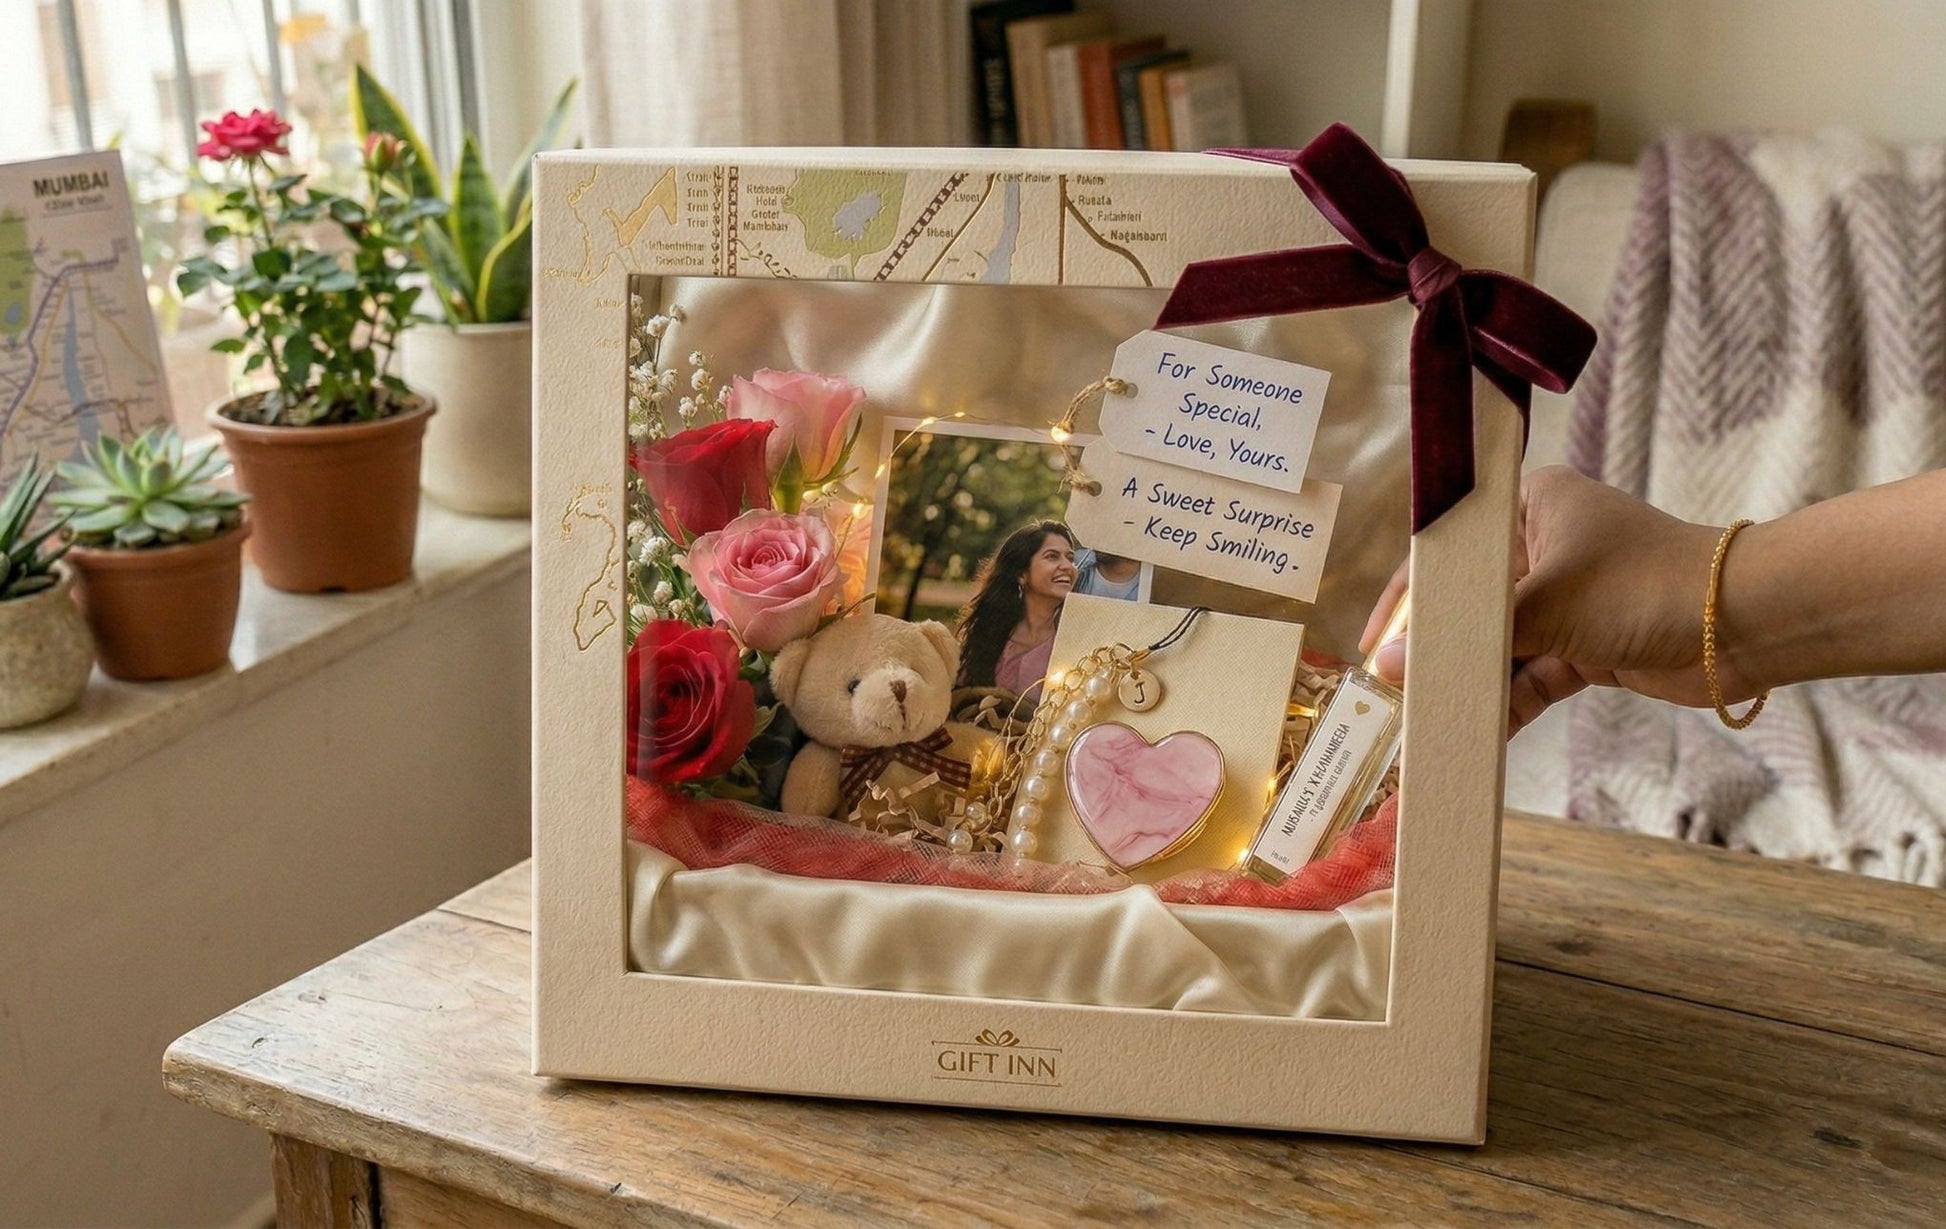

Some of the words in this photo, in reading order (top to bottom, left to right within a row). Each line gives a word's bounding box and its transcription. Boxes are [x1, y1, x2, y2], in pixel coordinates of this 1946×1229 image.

[33, 170, 109, 198] MUMBAI
[1157, 352, 1196, 380] For
[1205, 364, 1303, 404] Someone
[1178, 392, 1262, 431] Special,
[1163, 422, 1217, 460] Love,
[1229, 438, 1289, 473] Yours.
[1121, 477, 1138, 498] A
[1147, 483, 1215, 516] Sweet
[1223, 500, 1315, 539] Surprise
[1144, 516, 1198, 551] Keep
[1206, 531, 1300, 574] Smiling.
[1134, 681, 1146, 704] J
[937, 1050, 999, 1074] GIFT
[1008, 1054, 1056, 1078] INN
